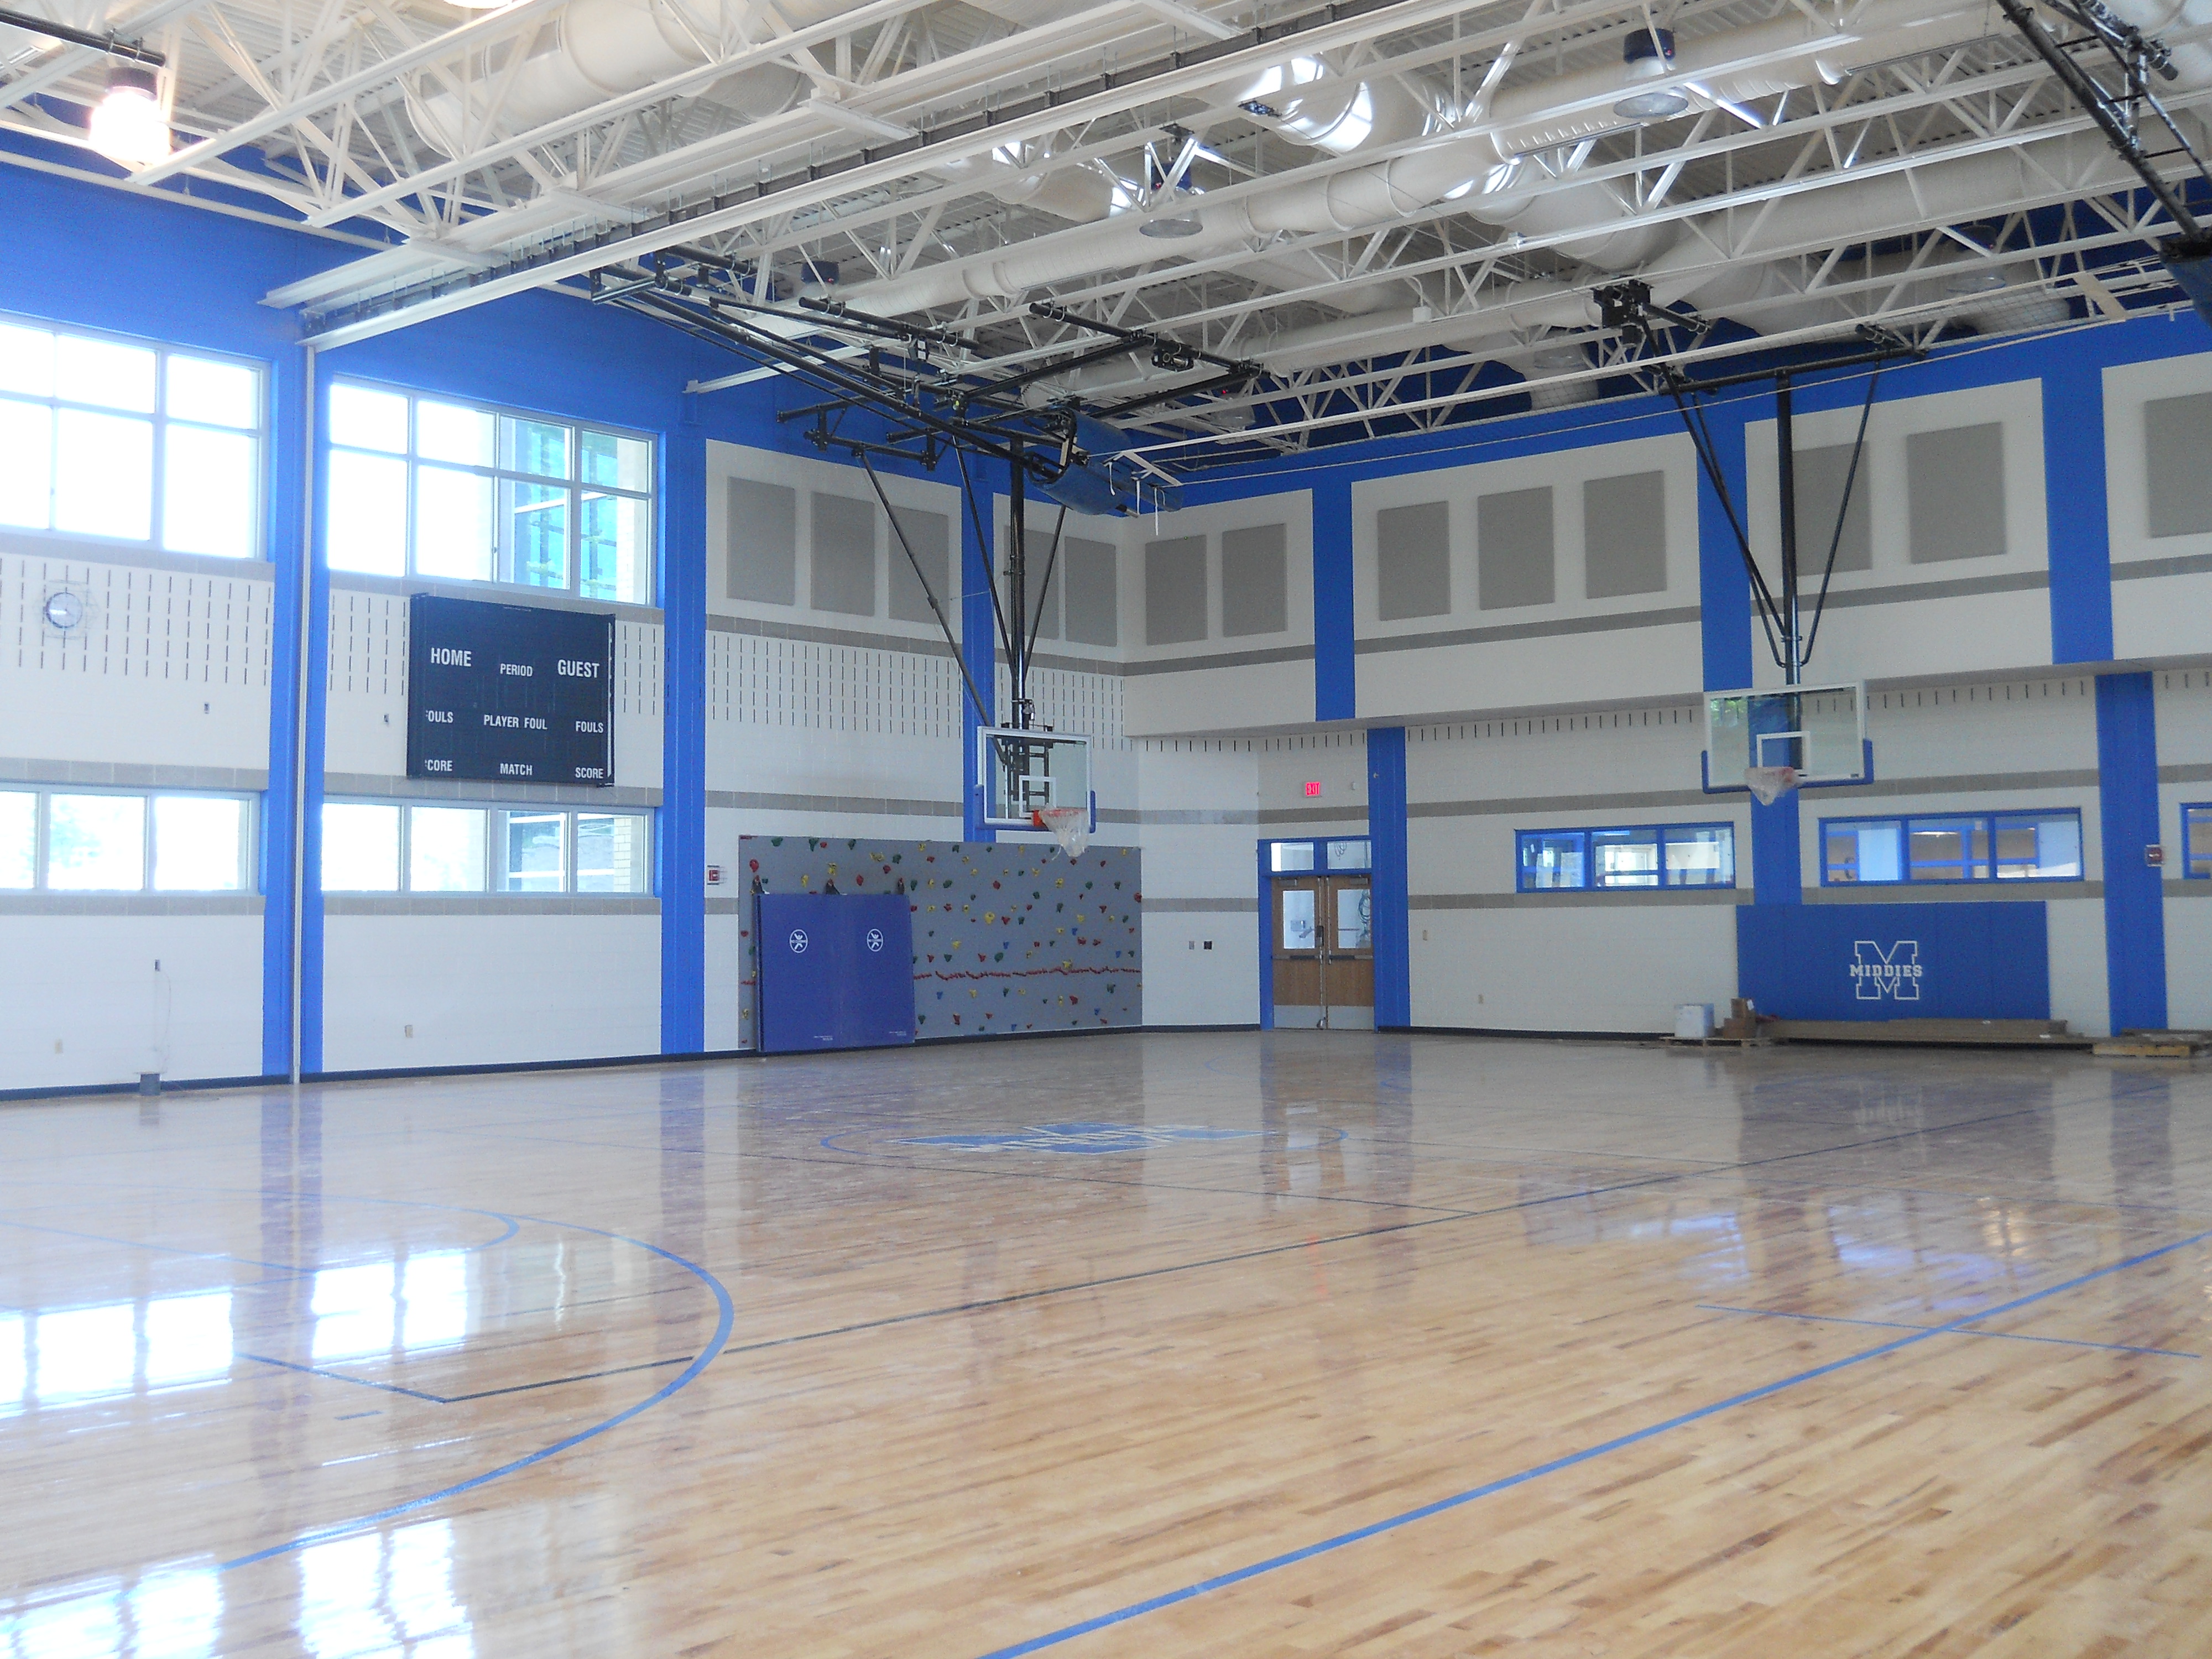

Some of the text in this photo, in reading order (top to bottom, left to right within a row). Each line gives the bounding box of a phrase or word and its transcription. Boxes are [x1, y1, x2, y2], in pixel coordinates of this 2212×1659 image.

[431, 648, 472, 667] HOME
[500, 663, 533, 677] PERIOD
[557, 659, 600, 678] GUEST
[426, 710, 453, 723] OULS
[484, 714, 547, 730] PLAYER FOUL
[576, 721, 604, 733] FOULS
[425, 759, 453, 771] CORE
[500, 763, 533, 775] MATCH
[575, 767, 604, 779] SCORE
[1306, 782, 1320, 795] EXIT
[1850, 964, 1922, 977] MIDDIES
